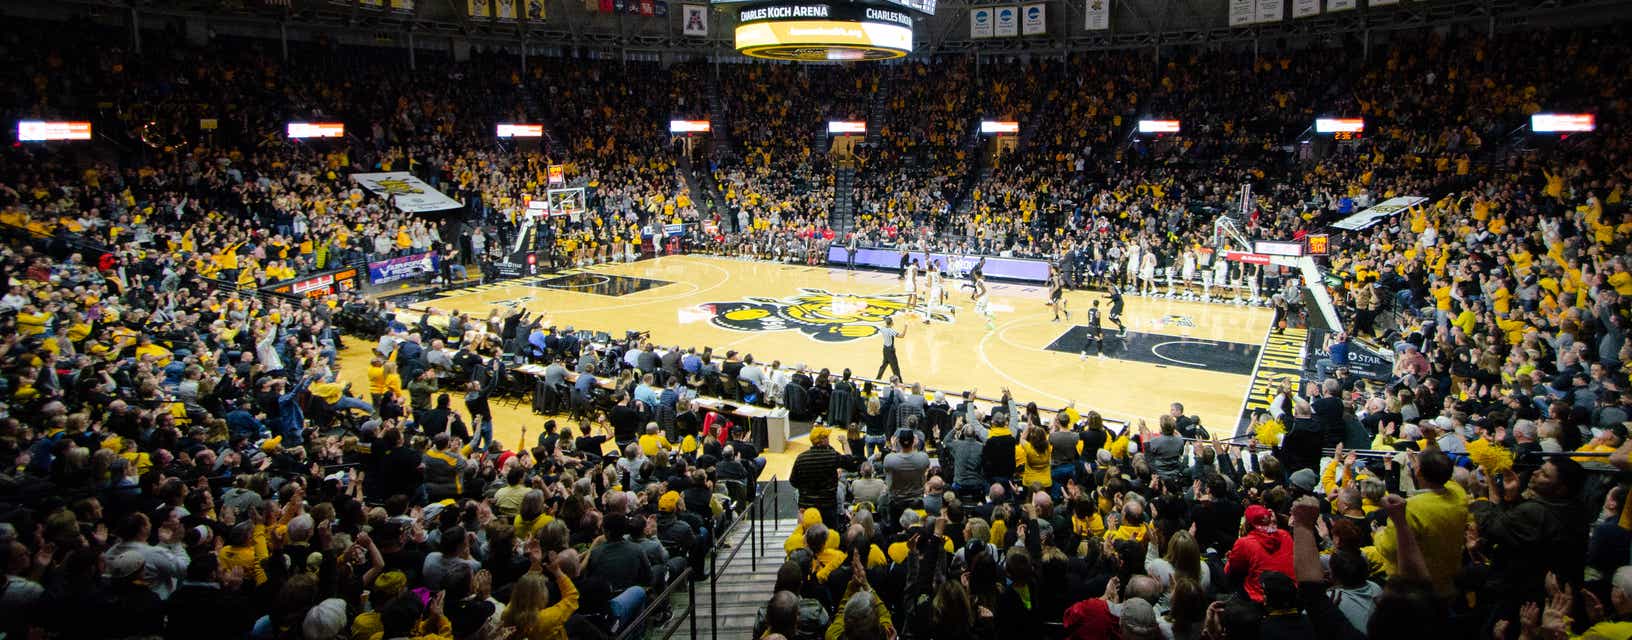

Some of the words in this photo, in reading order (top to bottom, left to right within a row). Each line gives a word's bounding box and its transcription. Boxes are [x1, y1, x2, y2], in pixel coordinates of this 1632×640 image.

[740, 8, 767, 21] CHARLES
[767, 7, 791, 18] KOCH
[793, 5, 828, 17] ARENA
[866, 7, 898, 21] CHARLES
[1358, 353, 1381, 365] STAR
